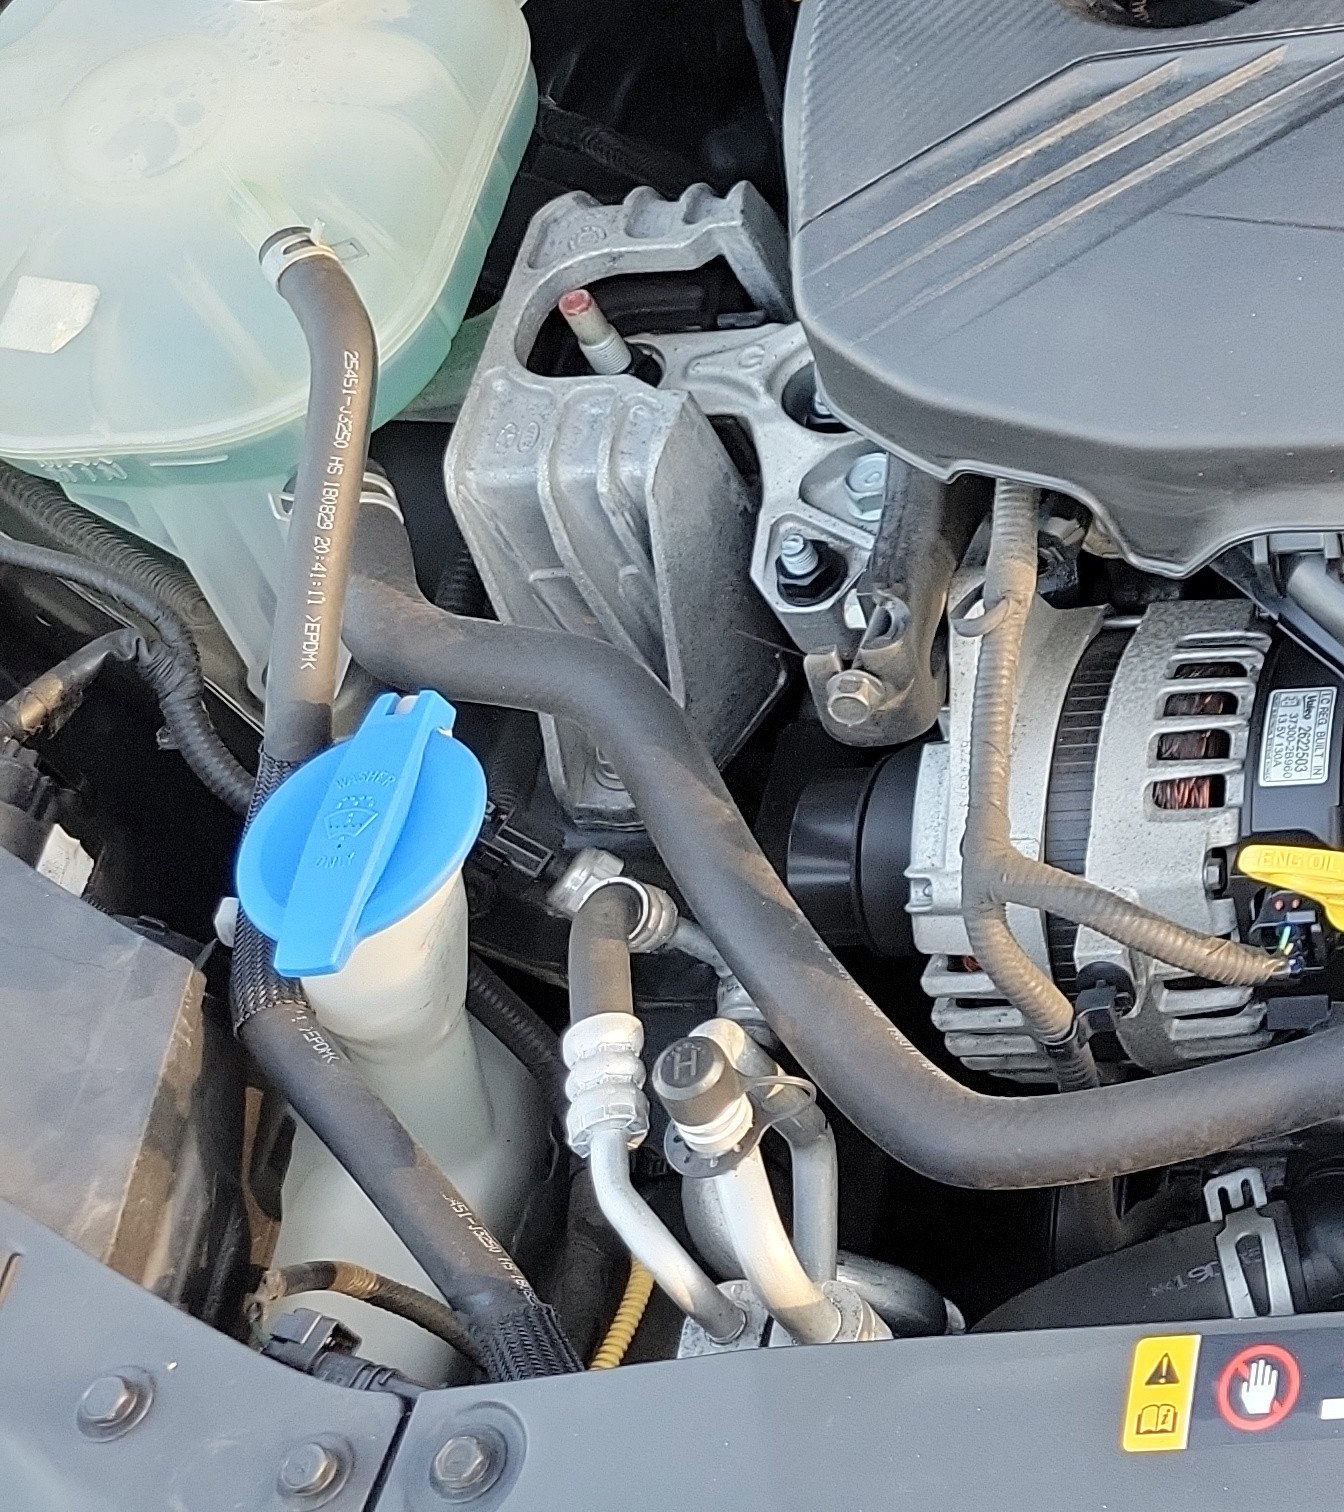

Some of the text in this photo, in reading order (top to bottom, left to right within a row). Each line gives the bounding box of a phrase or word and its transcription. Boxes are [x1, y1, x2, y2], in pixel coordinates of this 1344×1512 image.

[333, 350, 360, 449] 25451-J3250
[327, 456, 345, 475] HS
[317, 481, 341, 530] 180829
[1272, 743, 1283, 768] 130A
[1283, 713, 1299, 779] 37300-2B960
[1294, 726, 1312, 773] 2622503
[1314, 731, 1326, 758] BUILT
[1312, 765, 1323, 776] IN
[1257, 849, 1304, 867] ENG
